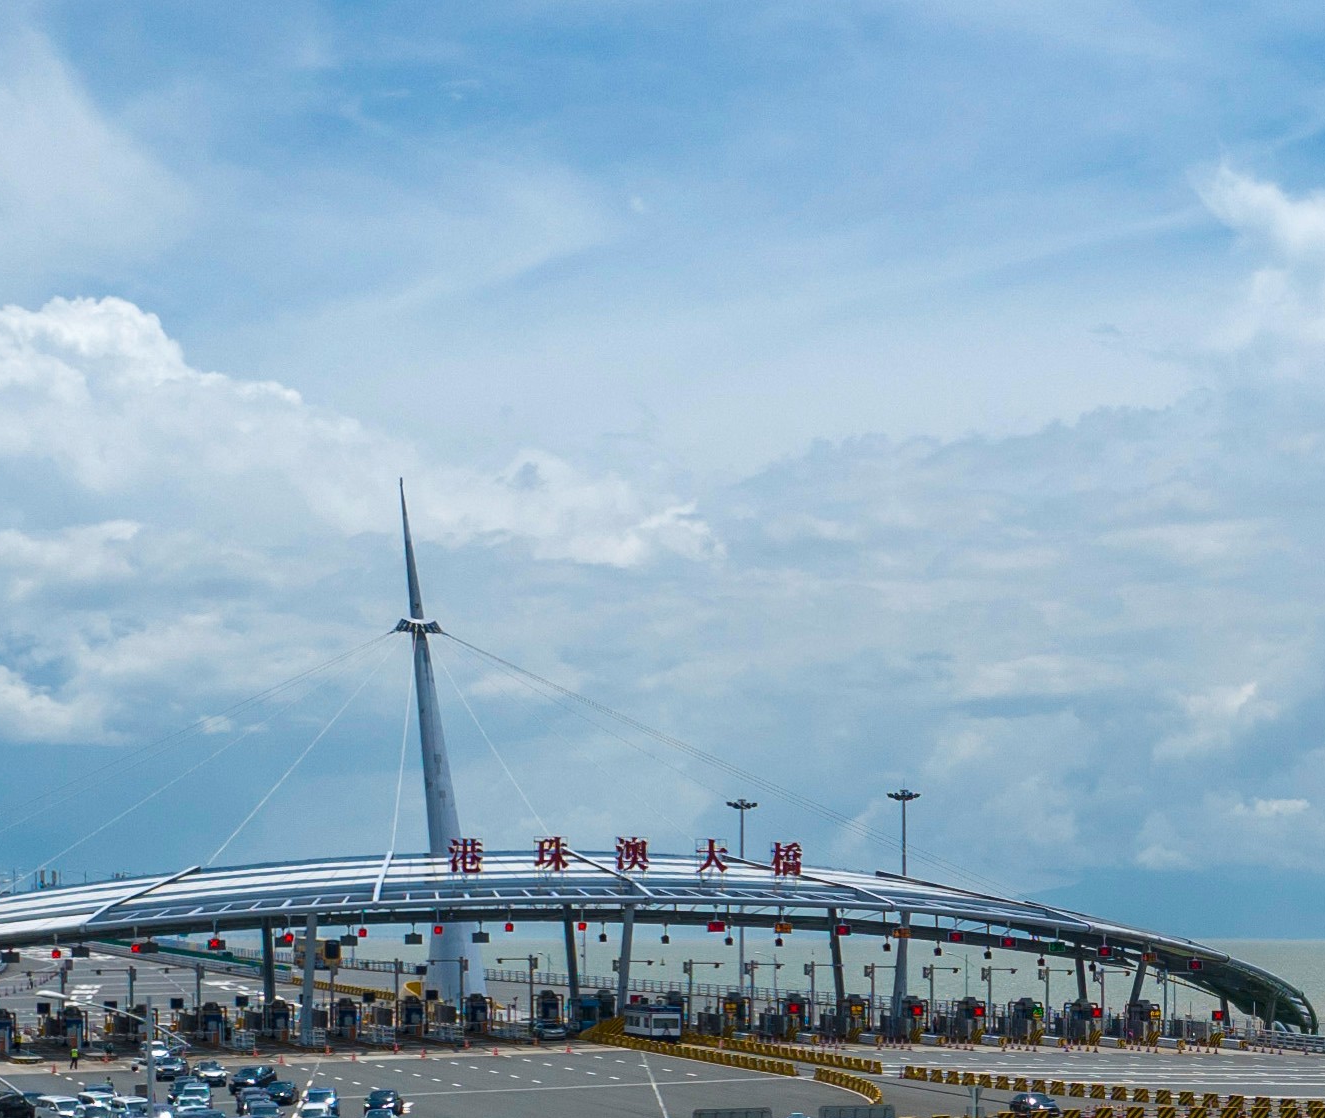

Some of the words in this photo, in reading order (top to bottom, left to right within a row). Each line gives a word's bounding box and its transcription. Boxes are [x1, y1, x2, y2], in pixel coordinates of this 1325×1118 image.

[448, 836, 803, 876] 港珠澳大橋
